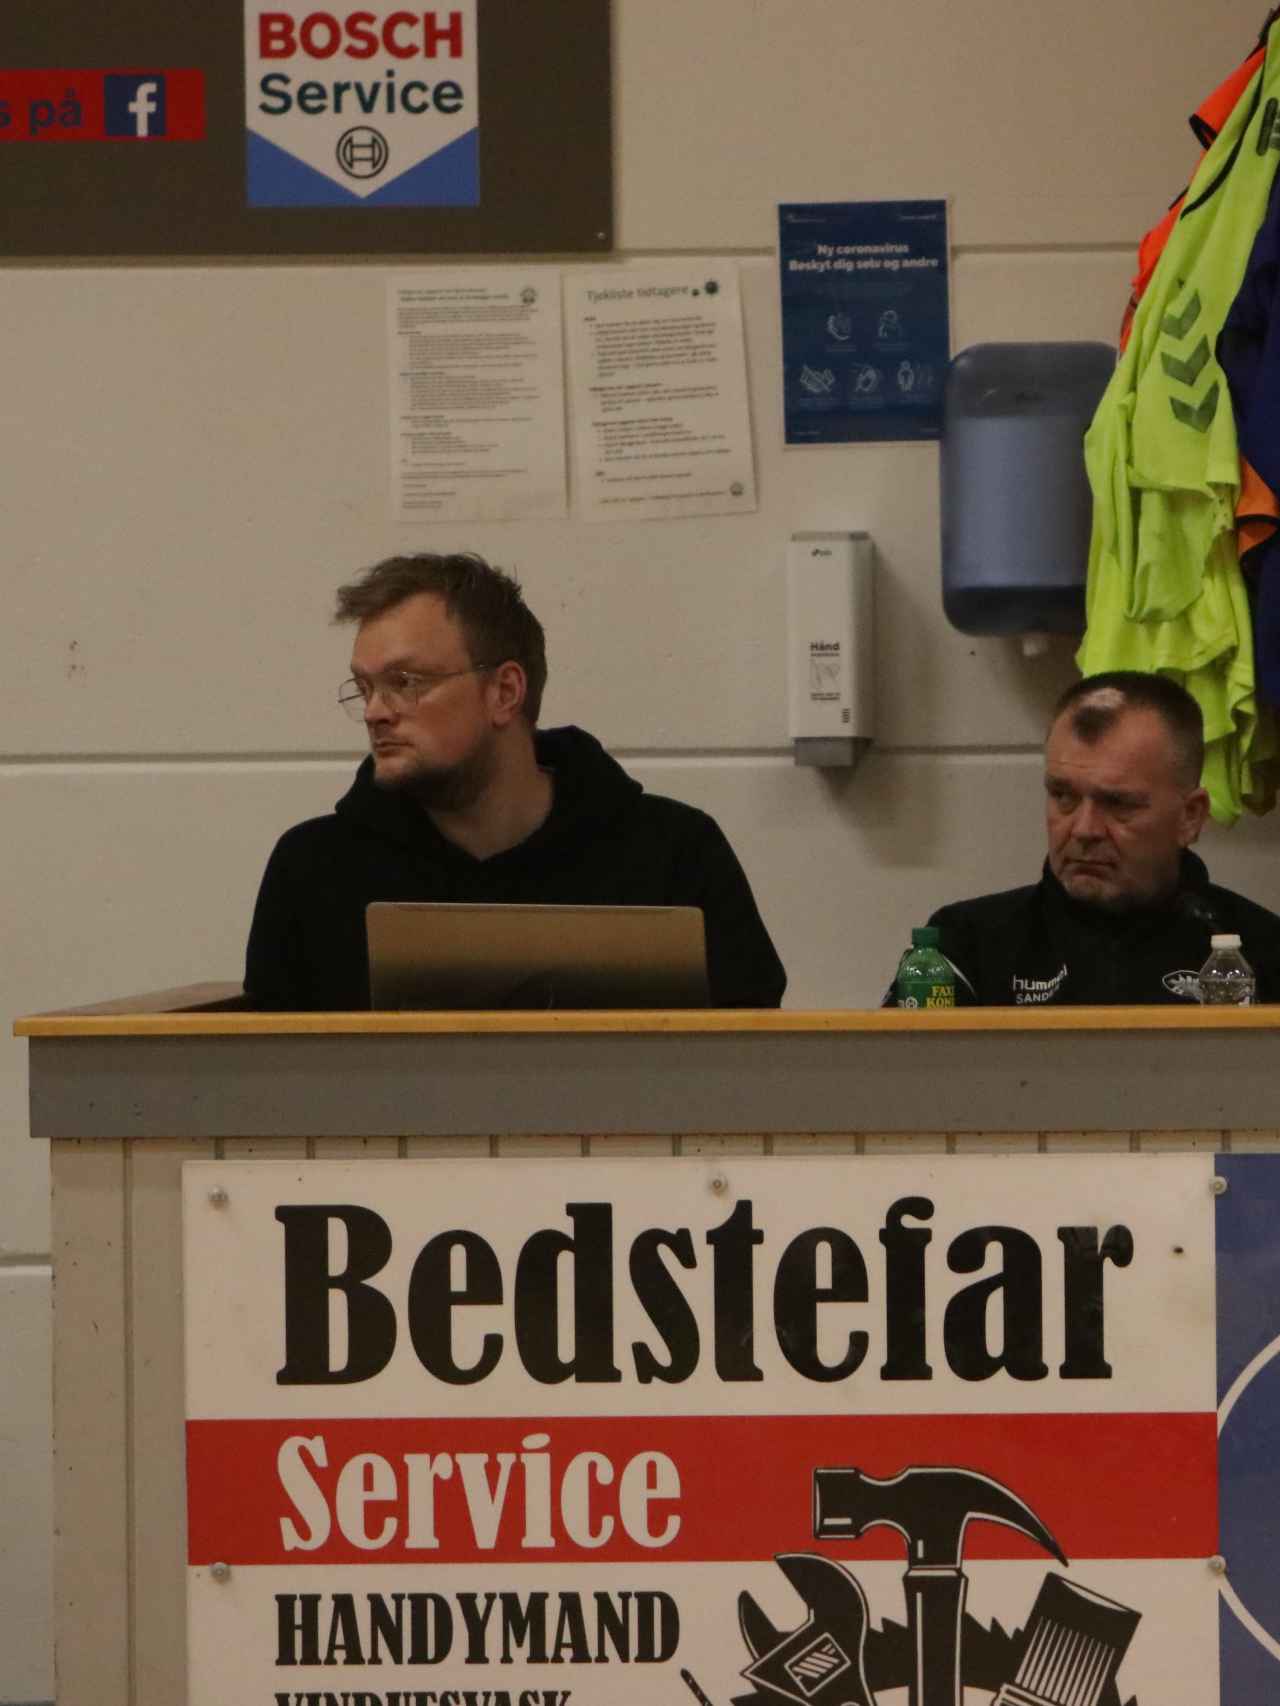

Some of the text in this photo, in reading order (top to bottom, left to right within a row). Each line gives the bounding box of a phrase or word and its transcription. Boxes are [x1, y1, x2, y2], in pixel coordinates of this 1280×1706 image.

[258, 12, 463, 59] BOSCH
[29, 87, 82, 135] på
[259, 70, 464, 115] Service
[789, 260, 831, 272] Beskyt
[833, 258, 854, 271] dig
[884, 260, 899, 271] og
[902, 257, 938, 269] andre
[816, 243, 909, 256] Ny coronavirus
[811, 641, 840, 651] Hånd
[1016, 992, 1054, 1004] SAND
[275, 1196, 1134, 1386] Bedstefar
[277, 1433, 681, 1552] Service
[275, 1591, 680, 1667] HANDYMAND
